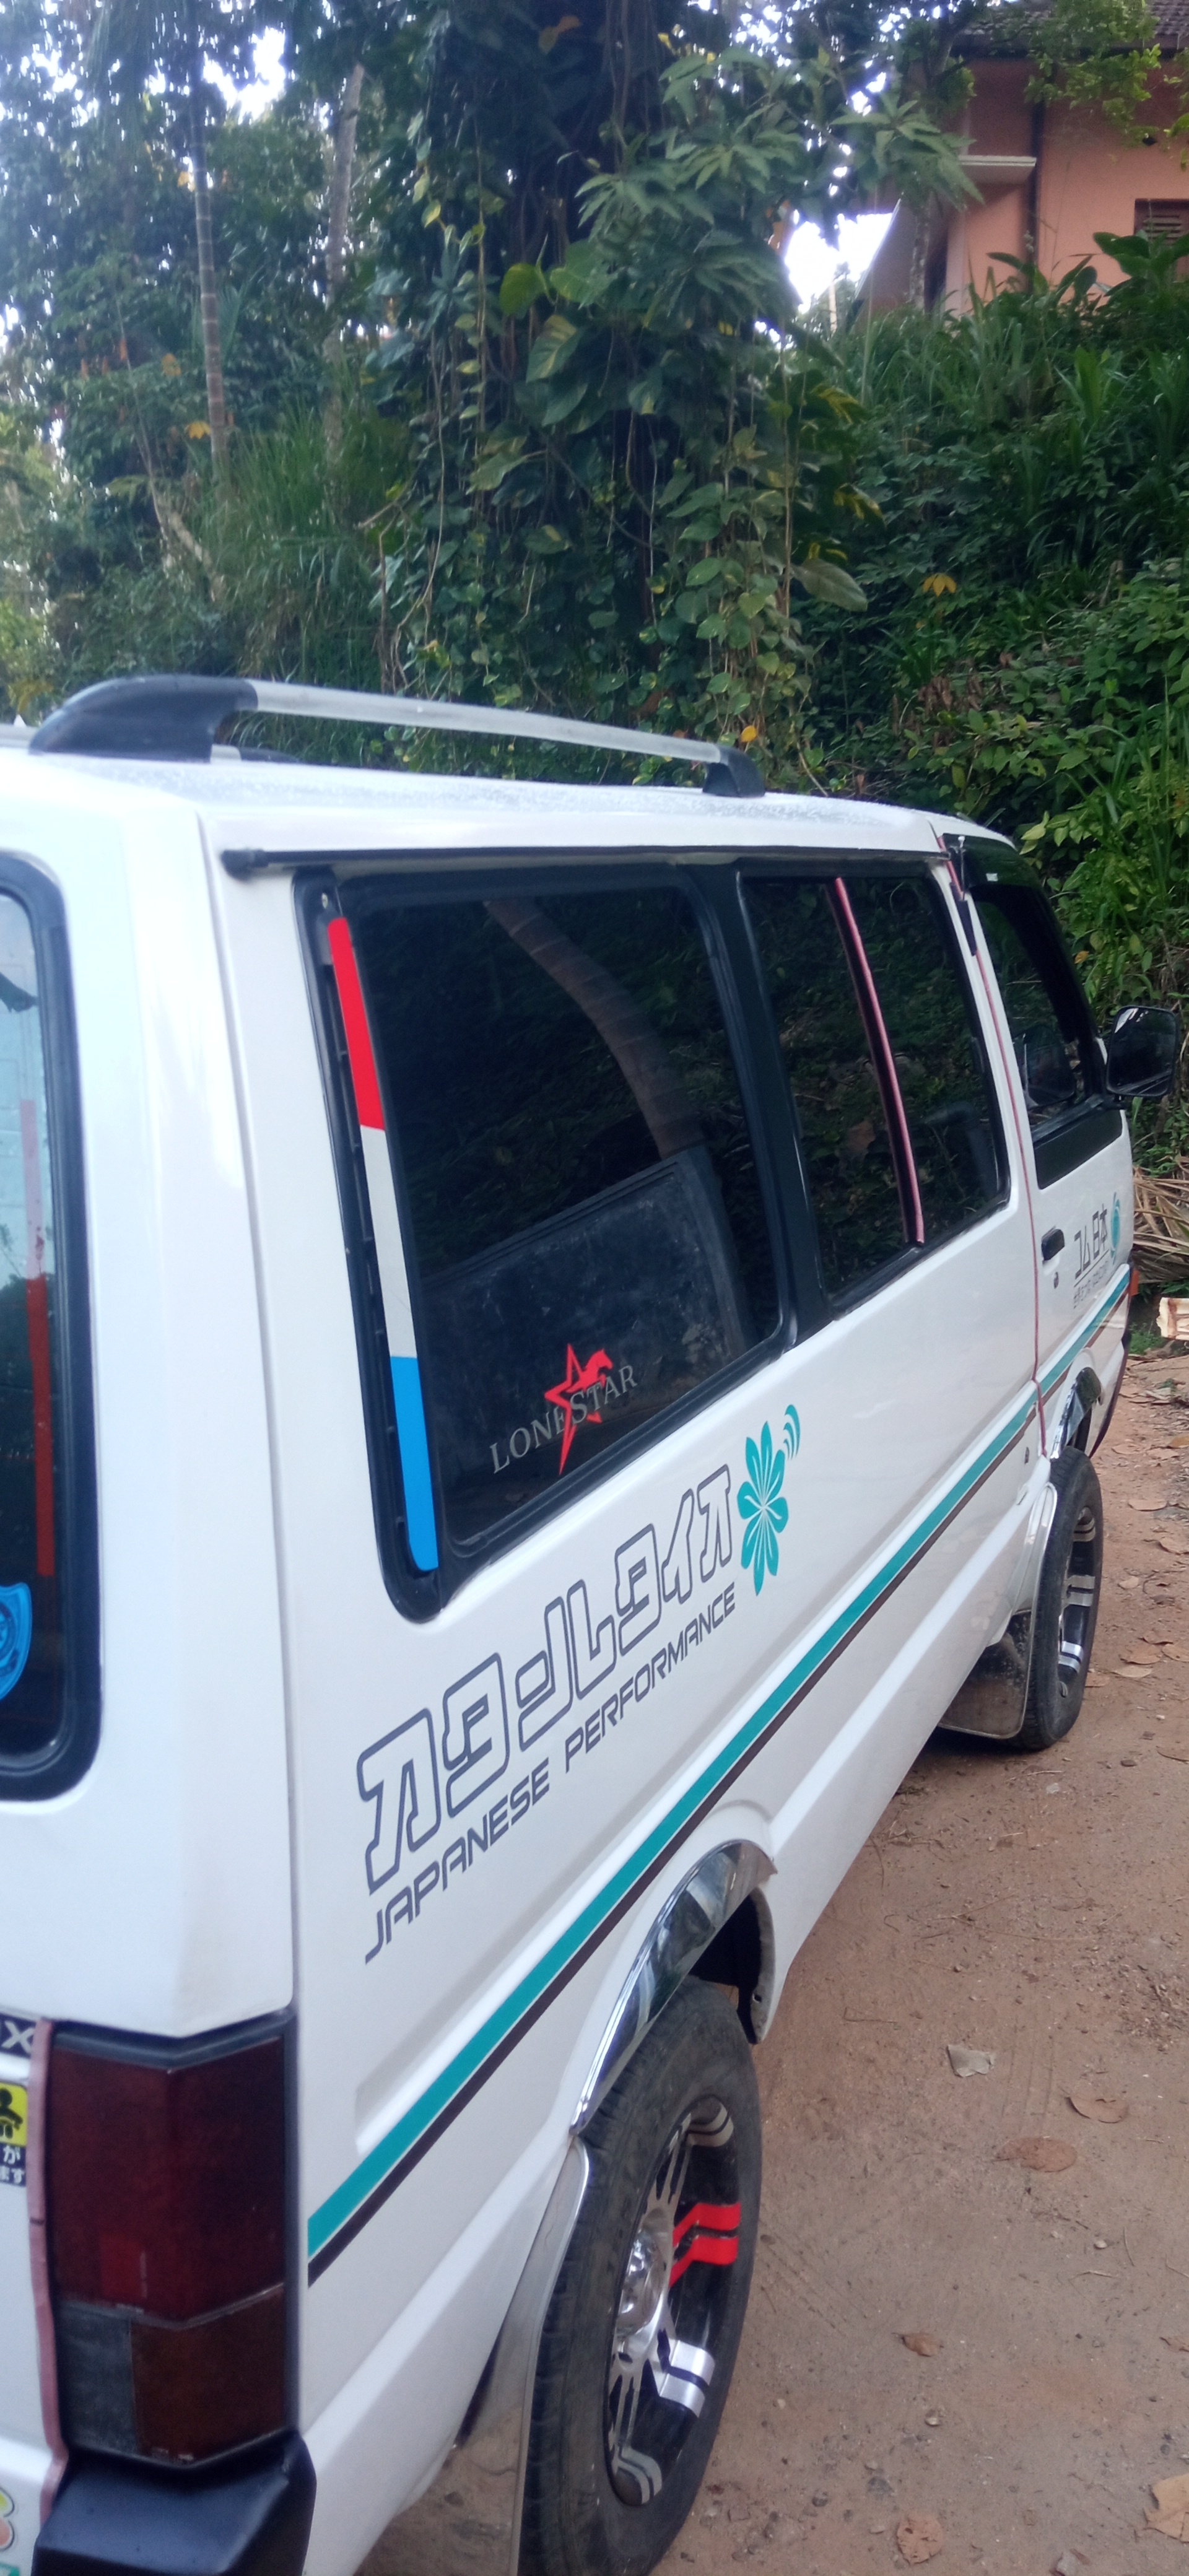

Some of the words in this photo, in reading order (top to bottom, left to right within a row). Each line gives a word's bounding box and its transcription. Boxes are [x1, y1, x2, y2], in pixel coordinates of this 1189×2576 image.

[489, 1365, 638, 1474] LONESTAR
[365, 1757, 551, 1964] JAPANESE
[564, 1581, 736, 1773] PERFORMANCE
